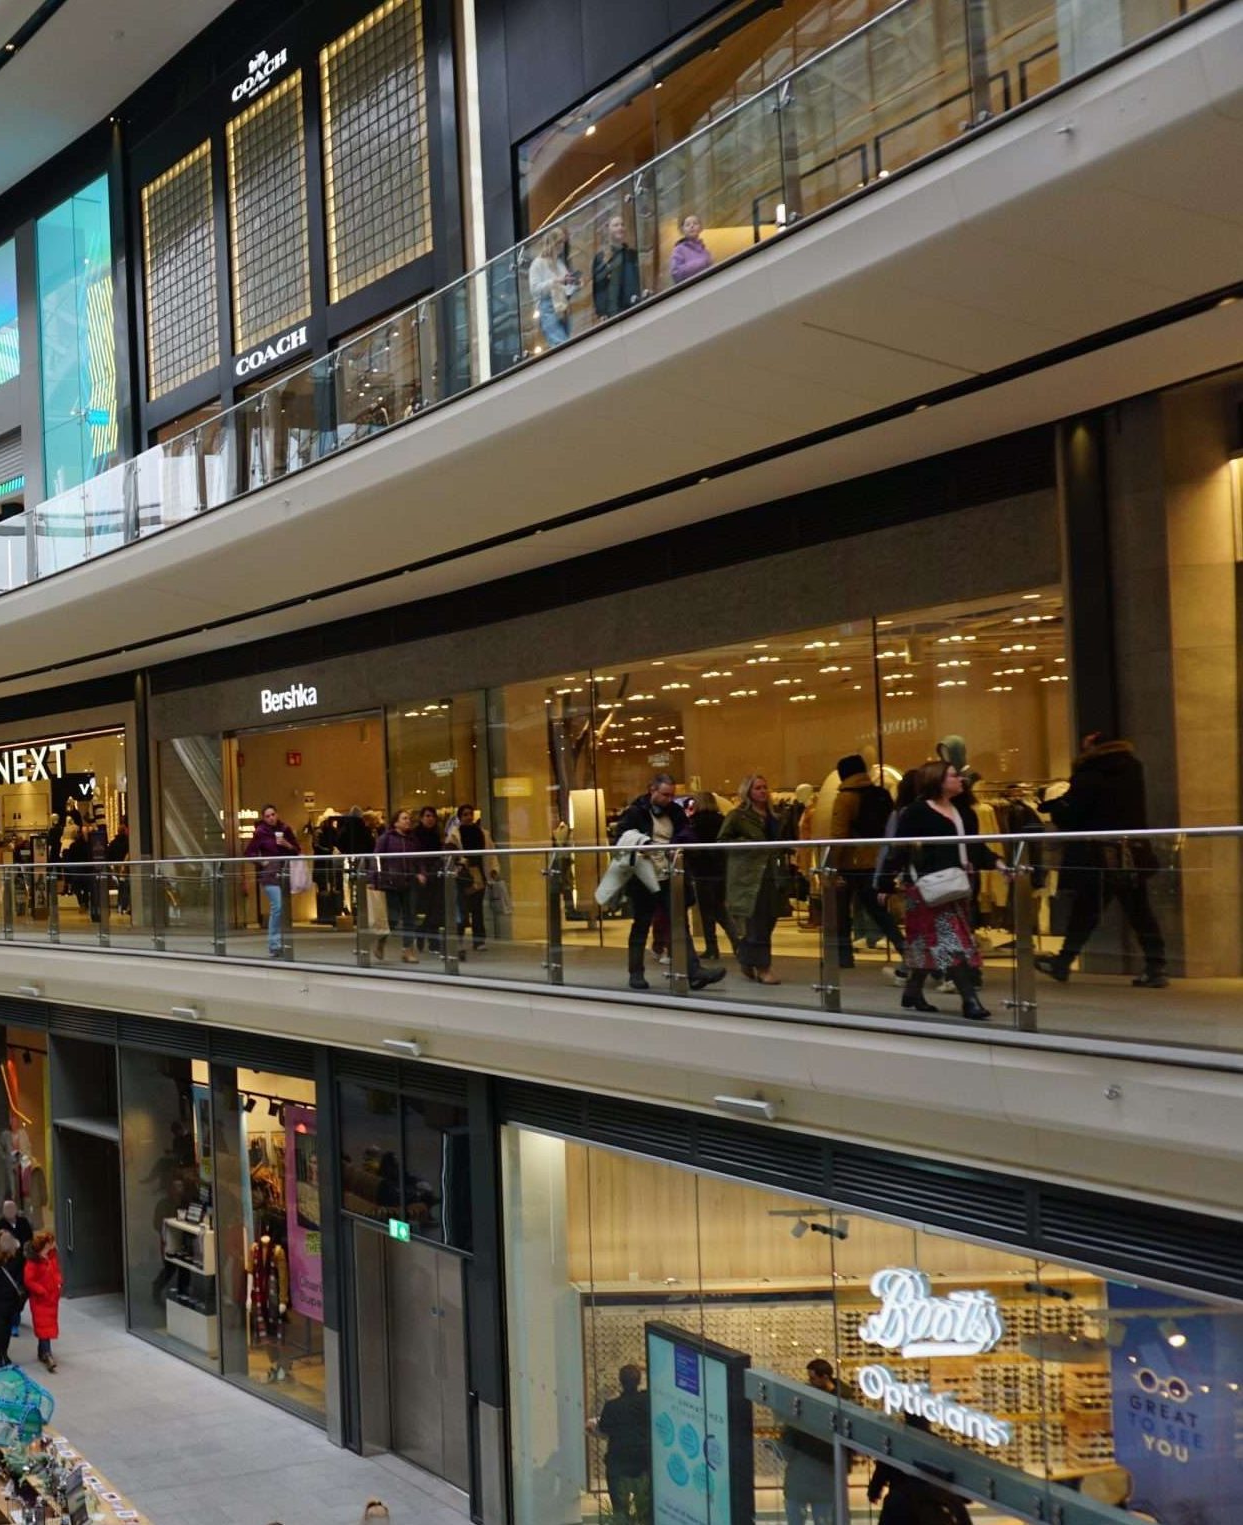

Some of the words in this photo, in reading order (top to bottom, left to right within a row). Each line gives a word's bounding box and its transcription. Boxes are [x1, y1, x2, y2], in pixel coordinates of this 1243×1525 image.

[231, 47, 288, 102] COACH
[235, 326, 307, 376] COACH
[260, 683, 318, 714] Bershka
[859, 1268, 1003, 1358] Boots
[859, 1364, 1011, 1447] Opticians
[1129, 1395, 1198, 1428] GREAT
[1127, 1412, 1155, 1434] TO
[1164, 1424, 1206, 1449] SEE
[1142, 1433, 1189, 1463] YOU
